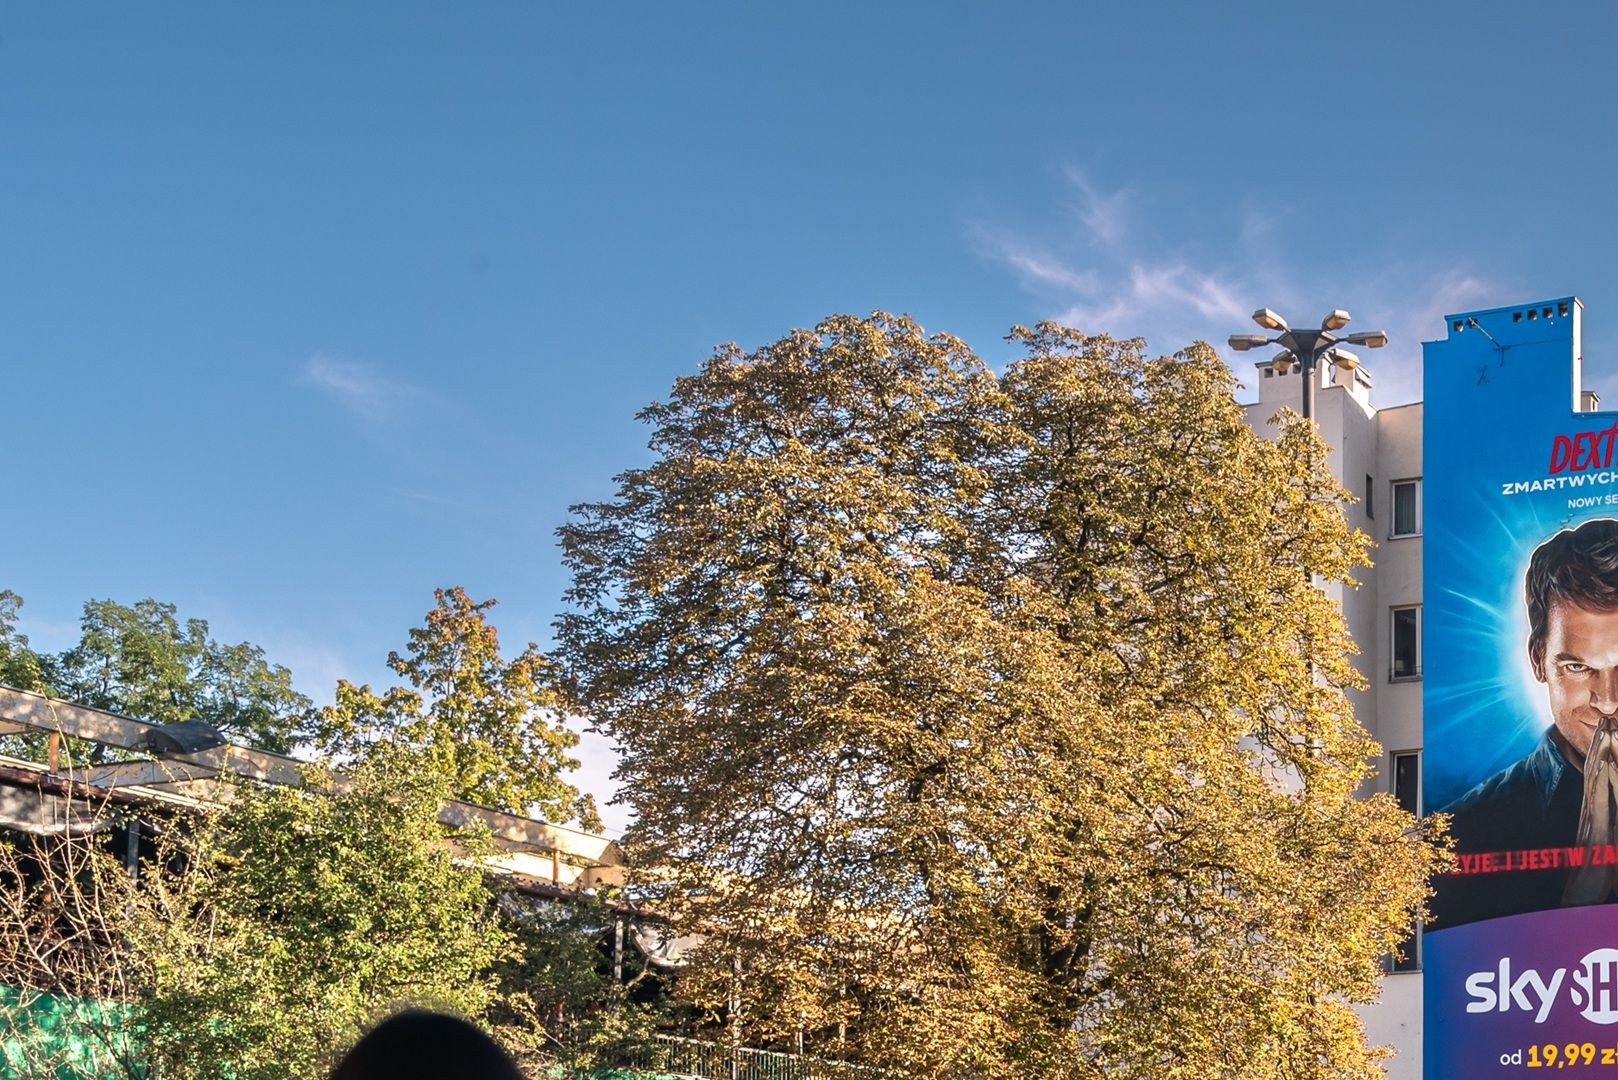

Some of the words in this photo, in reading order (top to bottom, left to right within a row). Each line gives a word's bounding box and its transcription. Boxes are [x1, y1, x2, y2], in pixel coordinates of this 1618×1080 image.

[1568, 495, 1602, 509] NOWY
[1453, 853, 1499, 875] YJE.
[1505, 852, 1512, 871] I
[1519, 848, 1561, 871] JEST
[1567, 846, 1585, 867] W
[1500, 1048, 1522, 1067] od
[1527, 1042, 1596, 1070] 19,99
